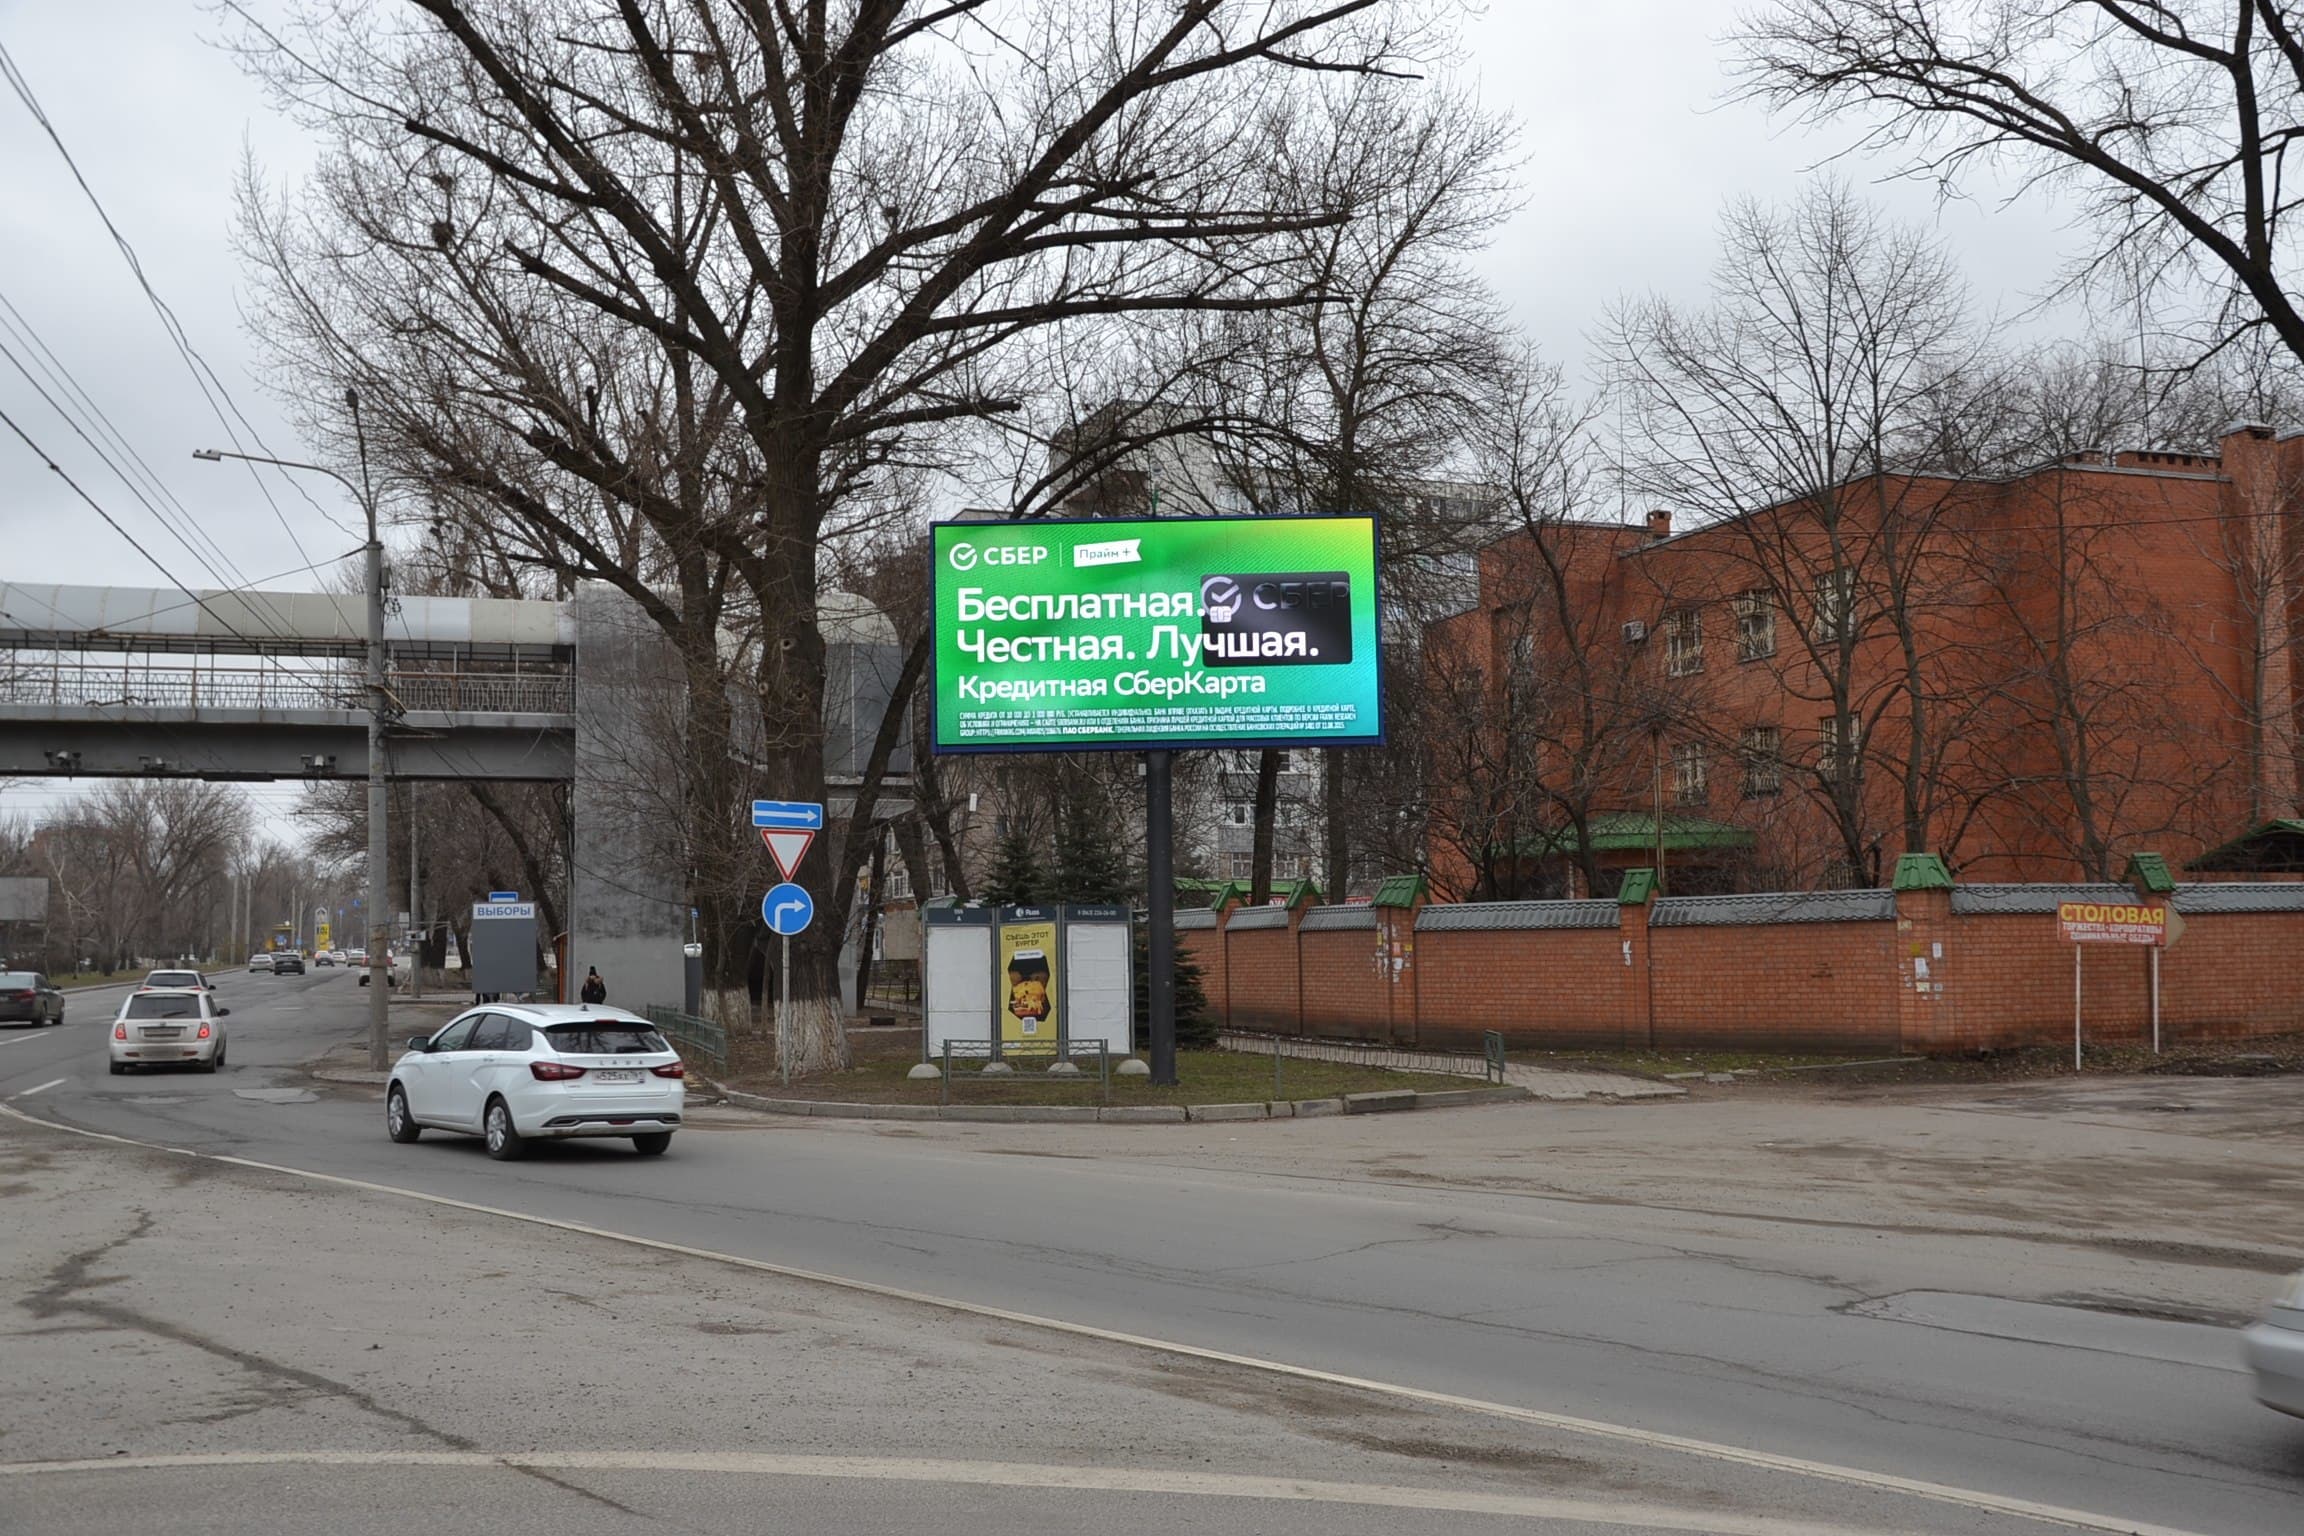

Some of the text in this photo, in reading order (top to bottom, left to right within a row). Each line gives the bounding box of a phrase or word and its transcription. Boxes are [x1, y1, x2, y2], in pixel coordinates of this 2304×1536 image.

[983, 545, 1048, 566] СБЕР
[1079, 547, 1119, 561] Прайм
[957, 587, 1206, 622] Бесплатная.
[1252, 581, 1350, 610] СБЕР
[956, 625, 1320, 667] Честная. Лучшая.
[958, 669, 1266, 705] Кредитная СберКарта
[1063, 726, 1077, 735] ПАО
[477, 906, 531, 916] ВЫБОРЫ
[2060, 903, 2165, 925] СТОЛОВАЯ
[1015, 939, 1040, 947] БУРГЕР
[1031, 931, 1049, 939] ЭТОТ
